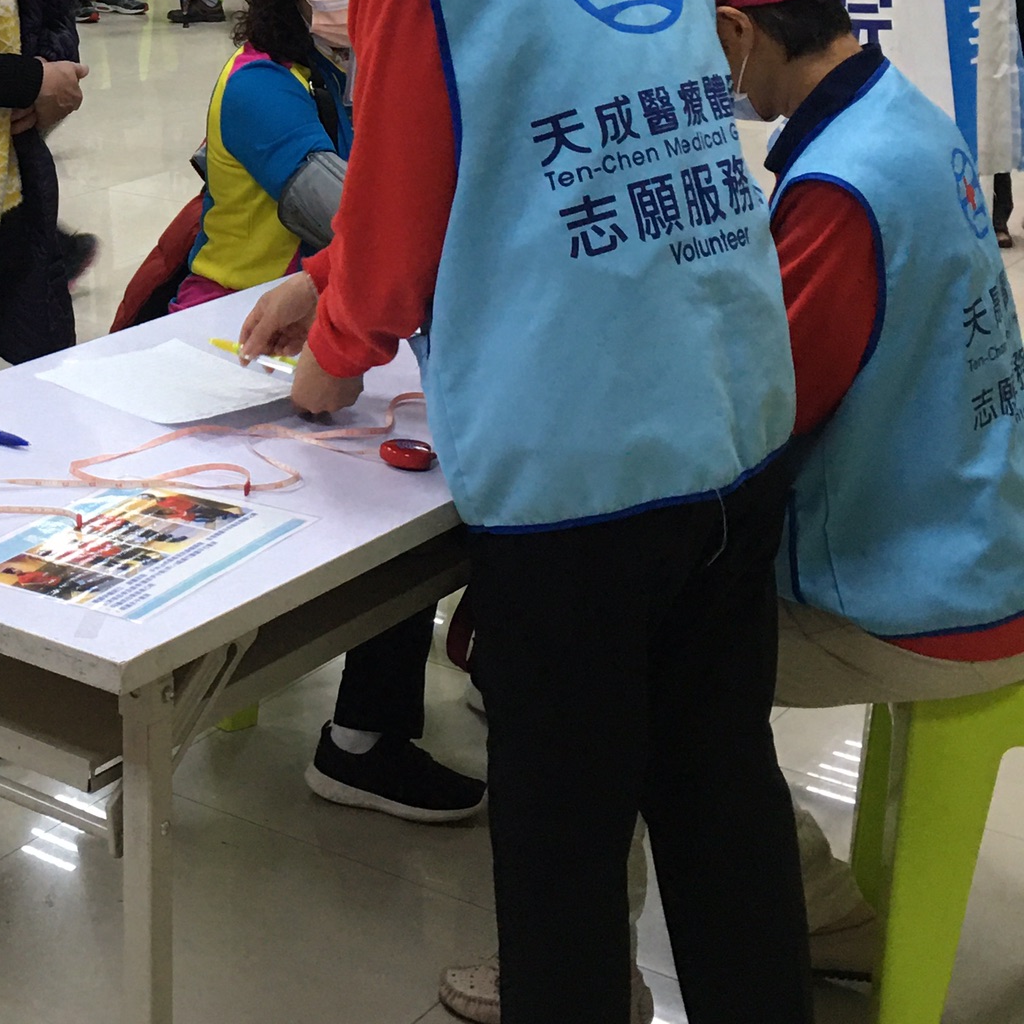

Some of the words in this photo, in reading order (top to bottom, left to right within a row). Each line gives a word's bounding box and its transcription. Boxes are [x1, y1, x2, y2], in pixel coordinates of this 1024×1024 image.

[544, 146, 660, 190] Ten-Chen
[664, 126, 727, 158] Medical
[559, 154, 764, 259] 志願服務
[670, 226, 750, 265] Volunteer
